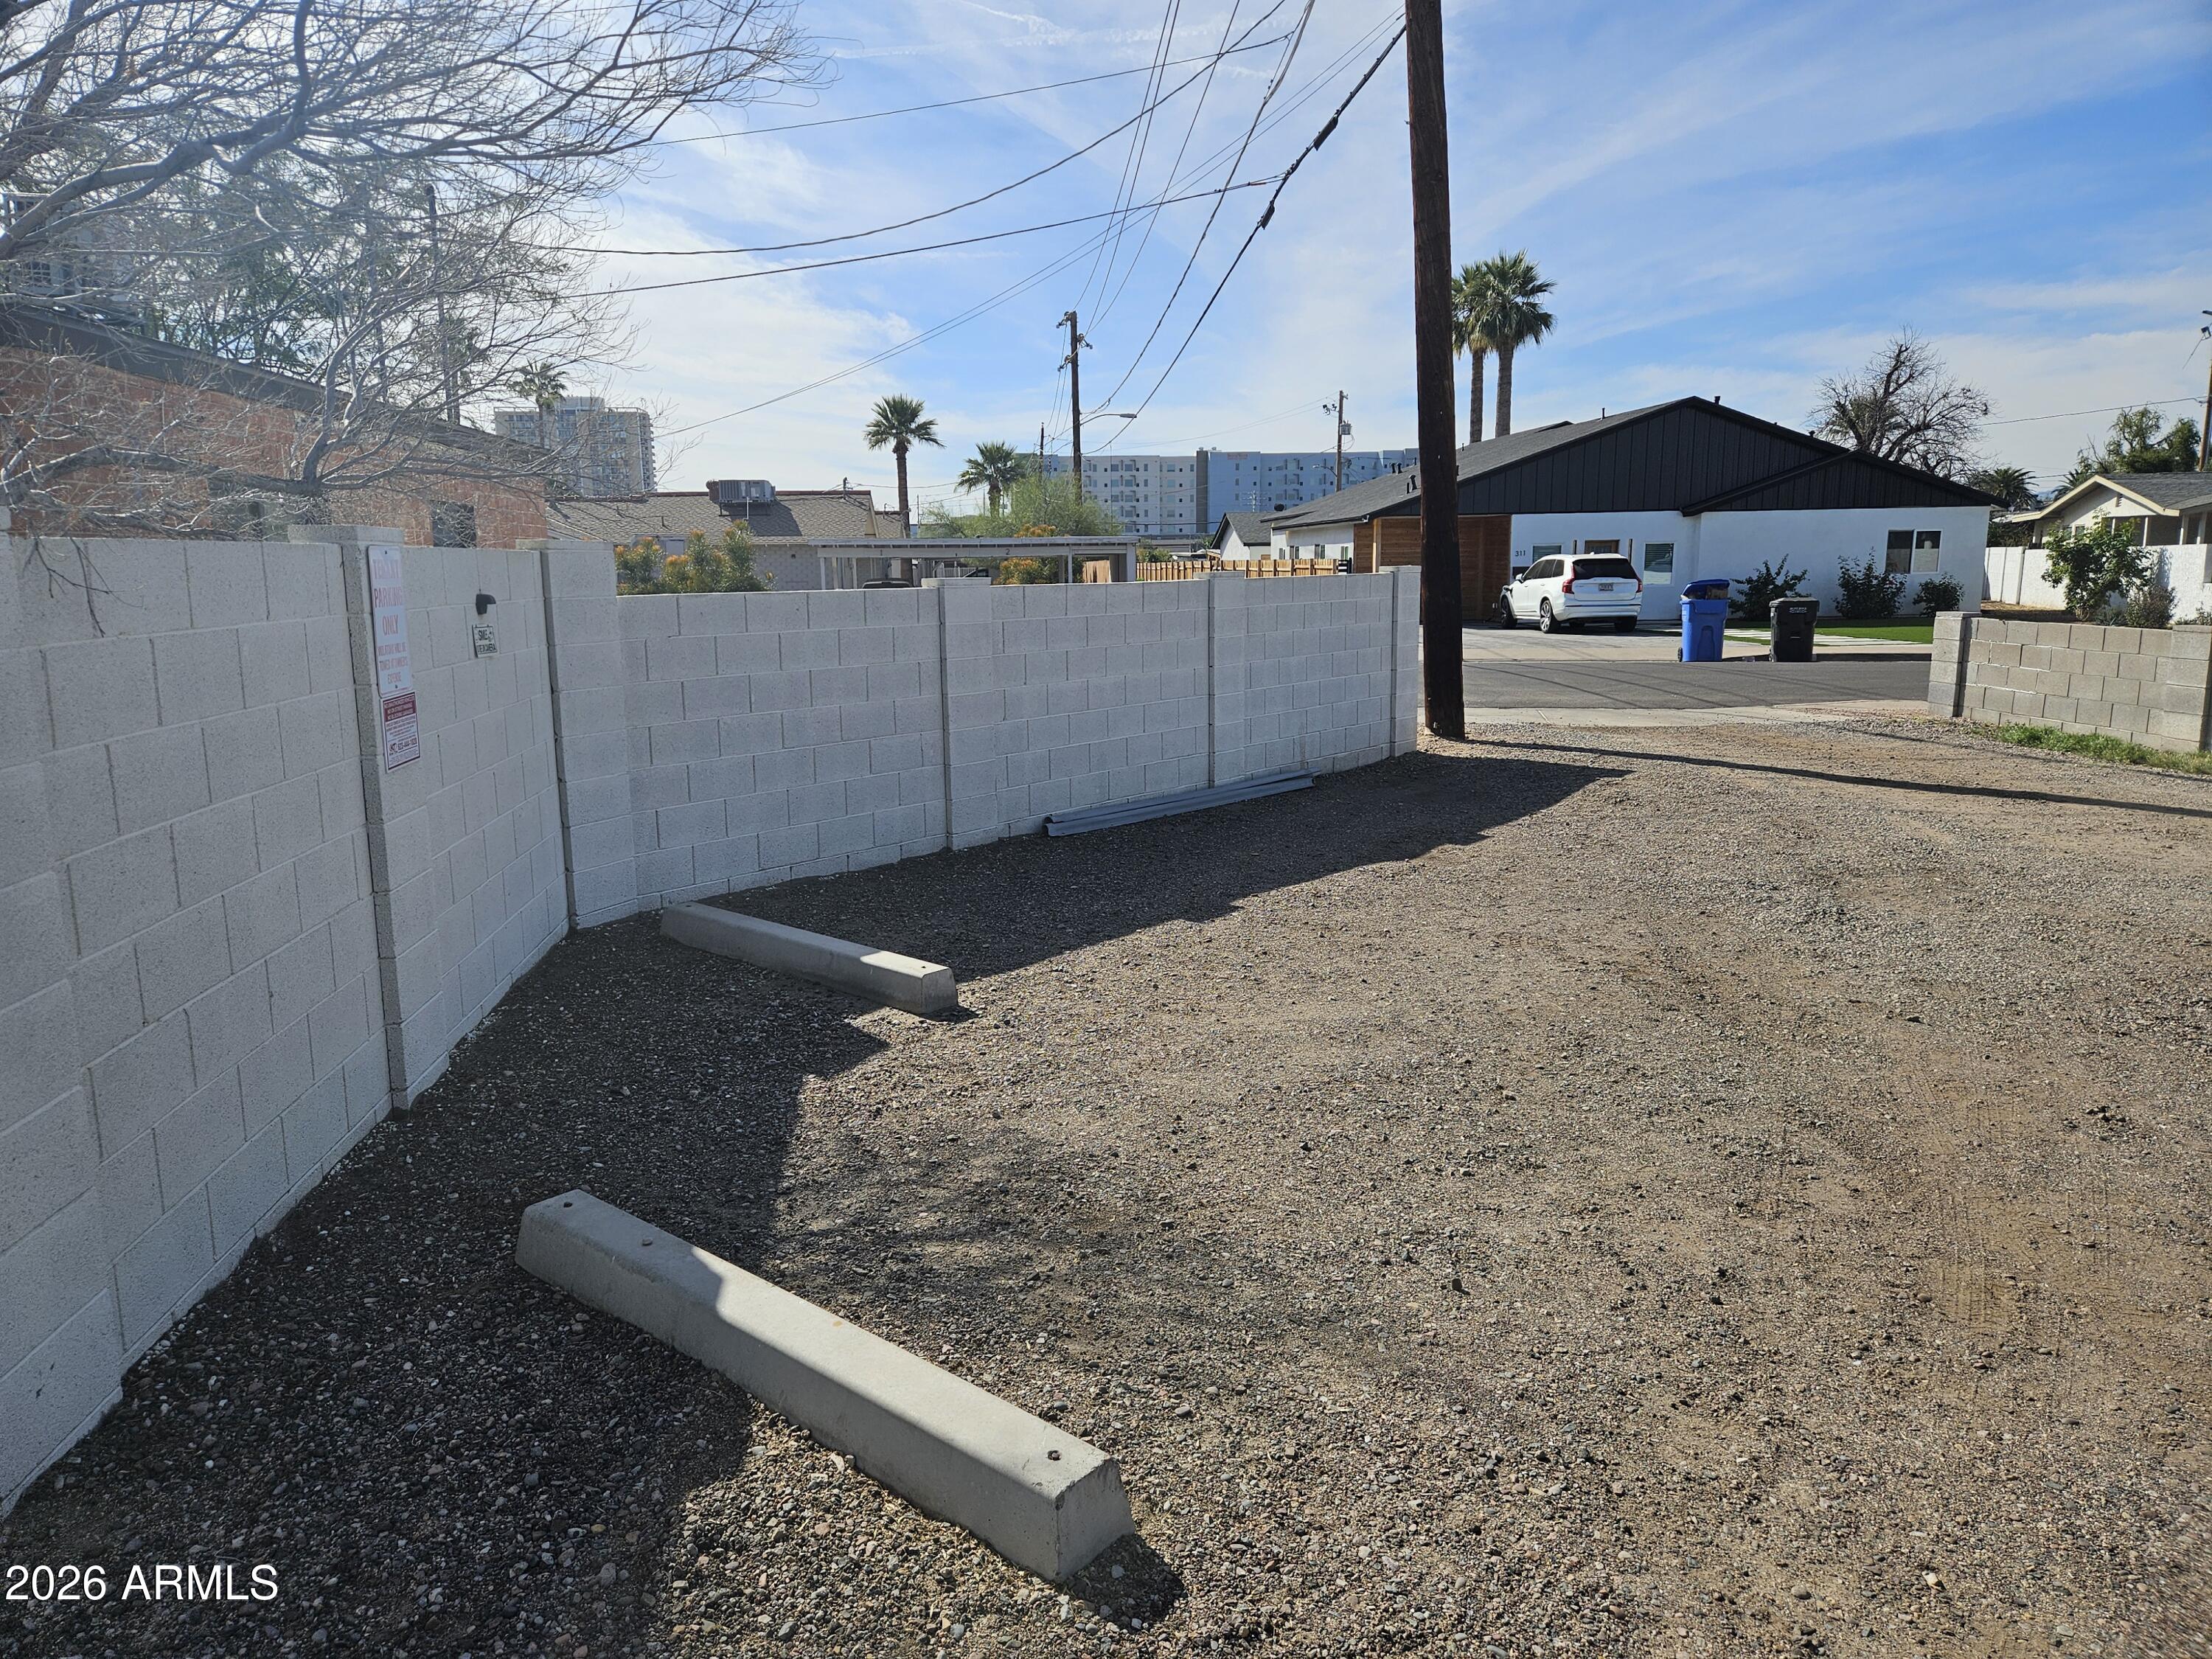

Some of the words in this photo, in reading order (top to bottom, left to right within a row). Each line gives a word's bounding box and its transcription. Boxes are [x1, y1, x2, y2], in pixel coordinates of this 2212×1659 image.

[372, 559, 400, 579] TENANT
[374, 585, 402, 608] PARKING
[382, 613, 399, 636] ONLY
